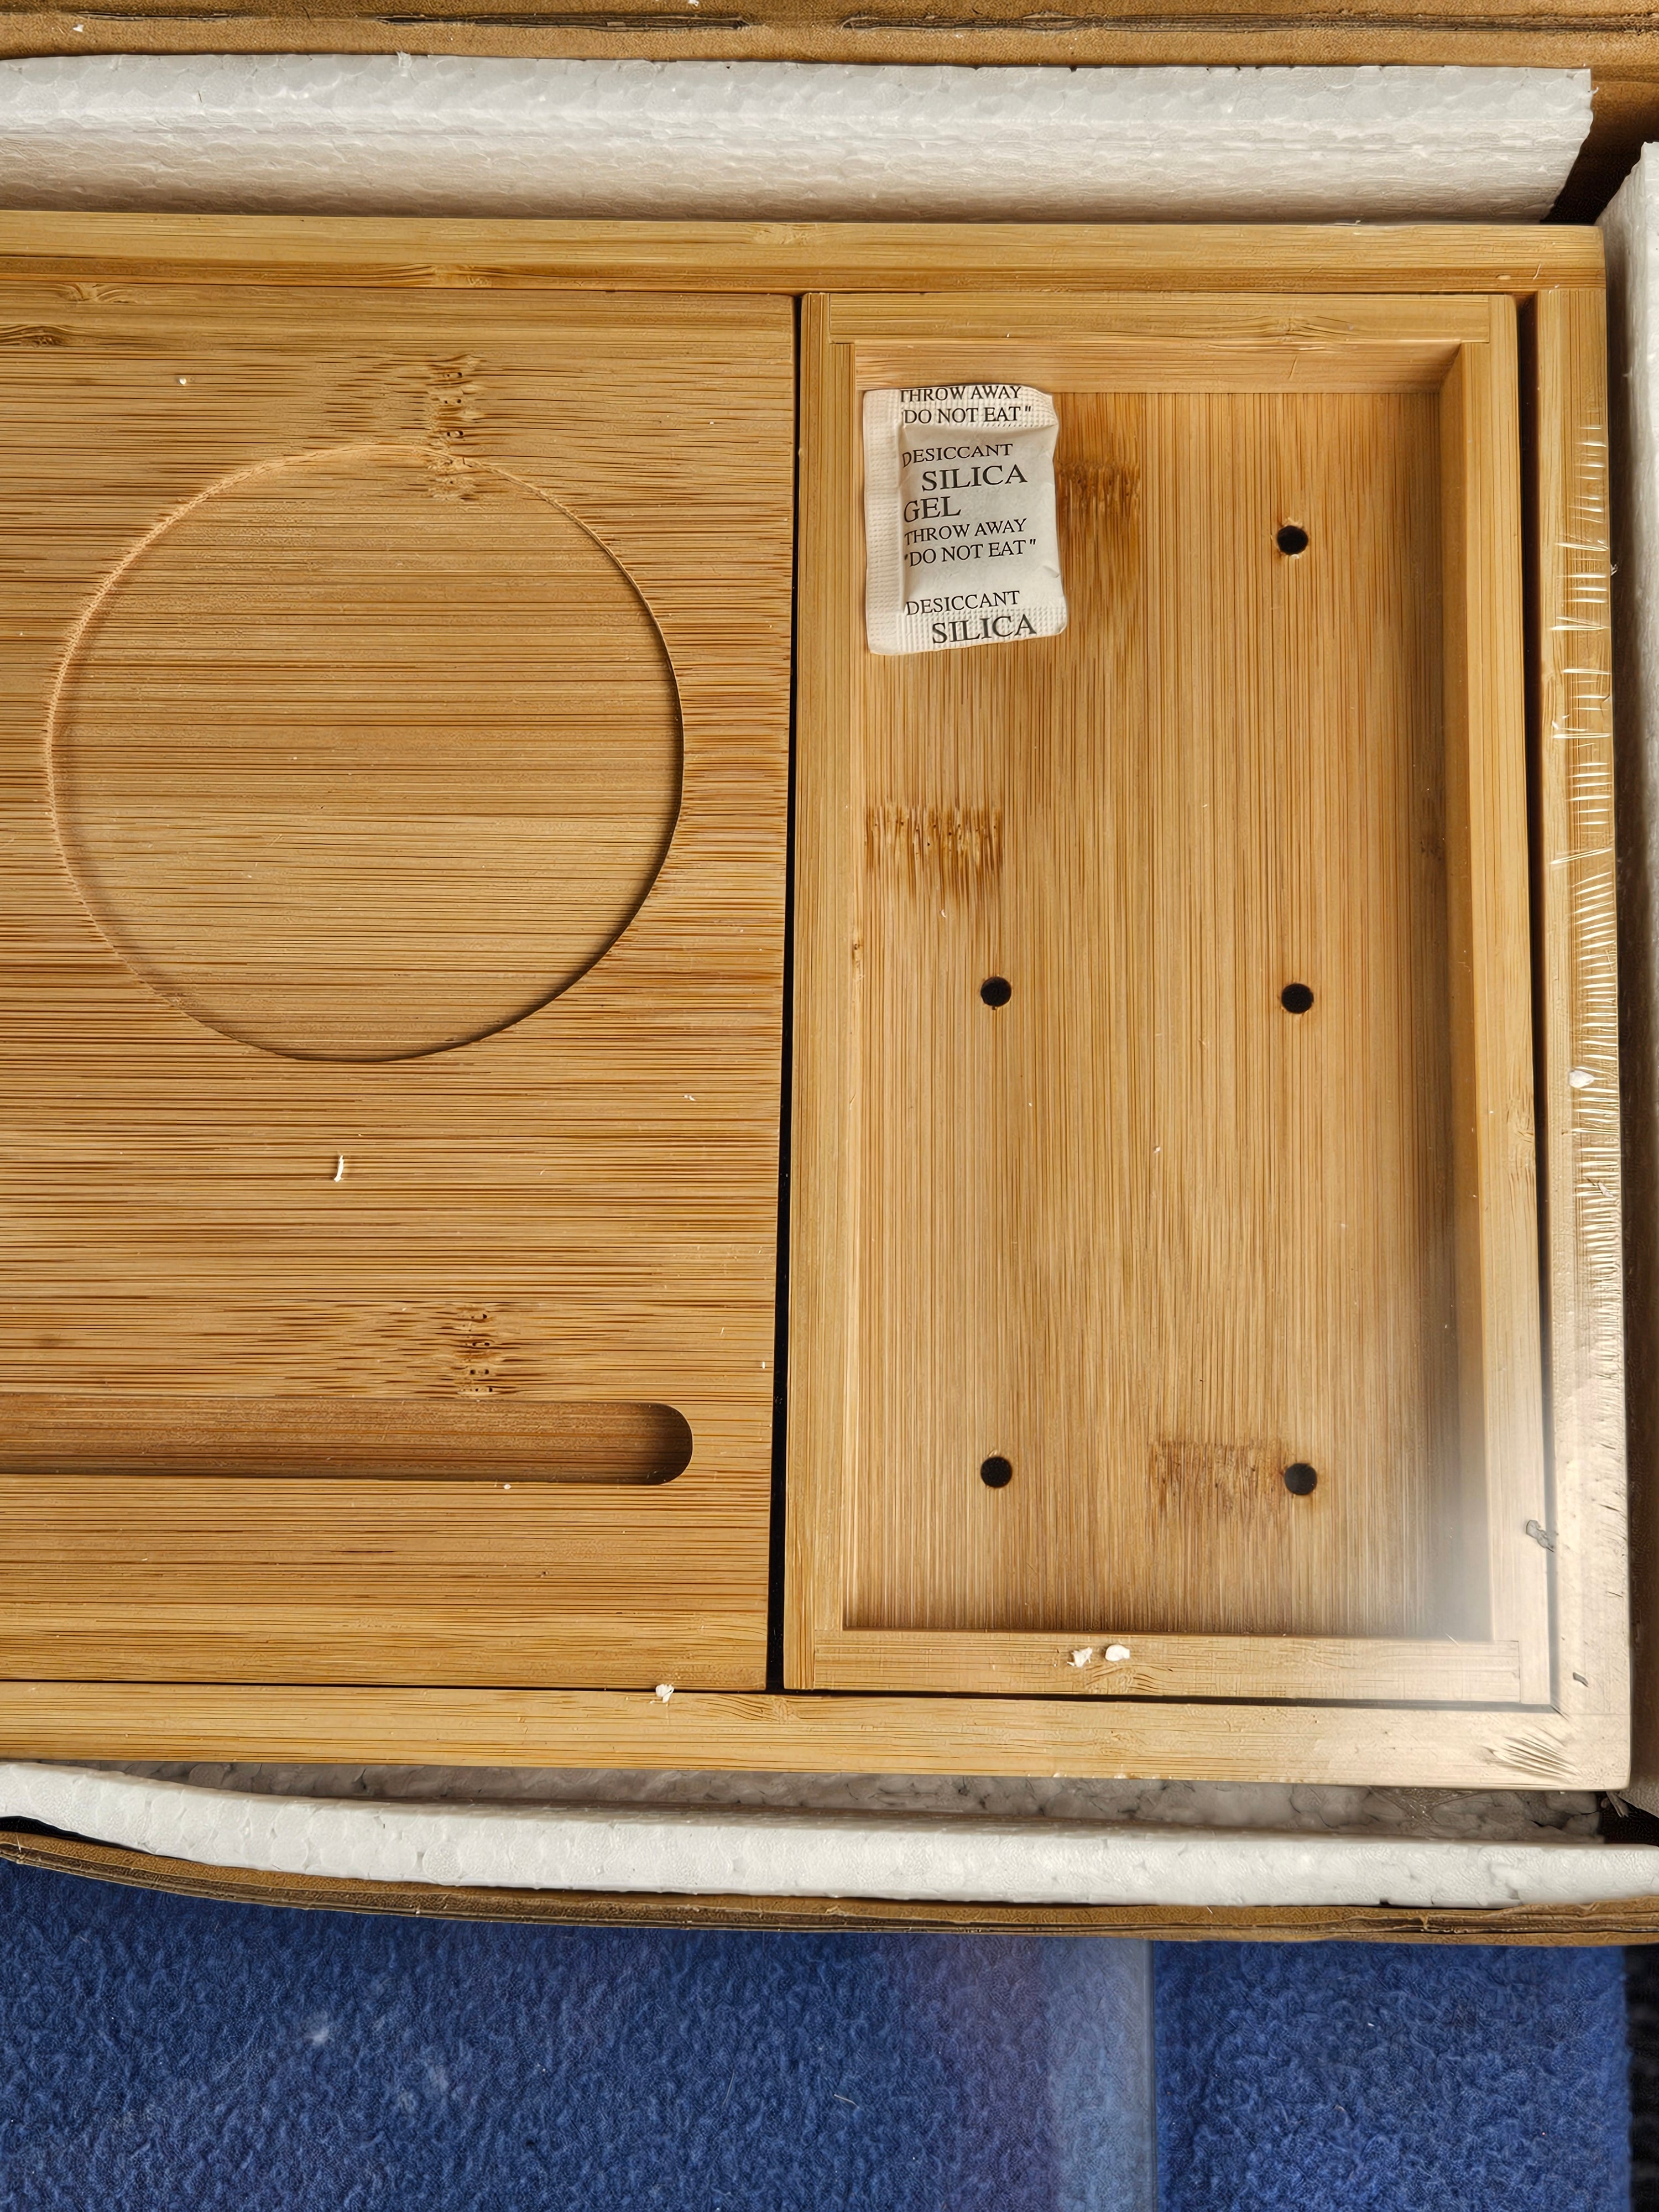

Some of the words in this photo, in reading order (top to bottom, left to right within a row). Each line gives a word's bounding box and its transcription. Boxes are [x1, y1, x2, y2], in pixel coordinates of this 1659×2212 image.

[971, 385, 1022, 400] AWAY
[938, 407, 978, 424] NOT
[902, 444, 1013, 468] DESICCANT
[921, 464, 1027, 492] SILICA
[904, 496, 961, 523] GEL
[905, 524, 969, 545] THROW
[974, 518, 1027, 536] AWAY
[942, 544, 983, 562] NOT
[906, 591, 1020, 615] DESICCANT
[932, 614, 1037, 644] SILICA
